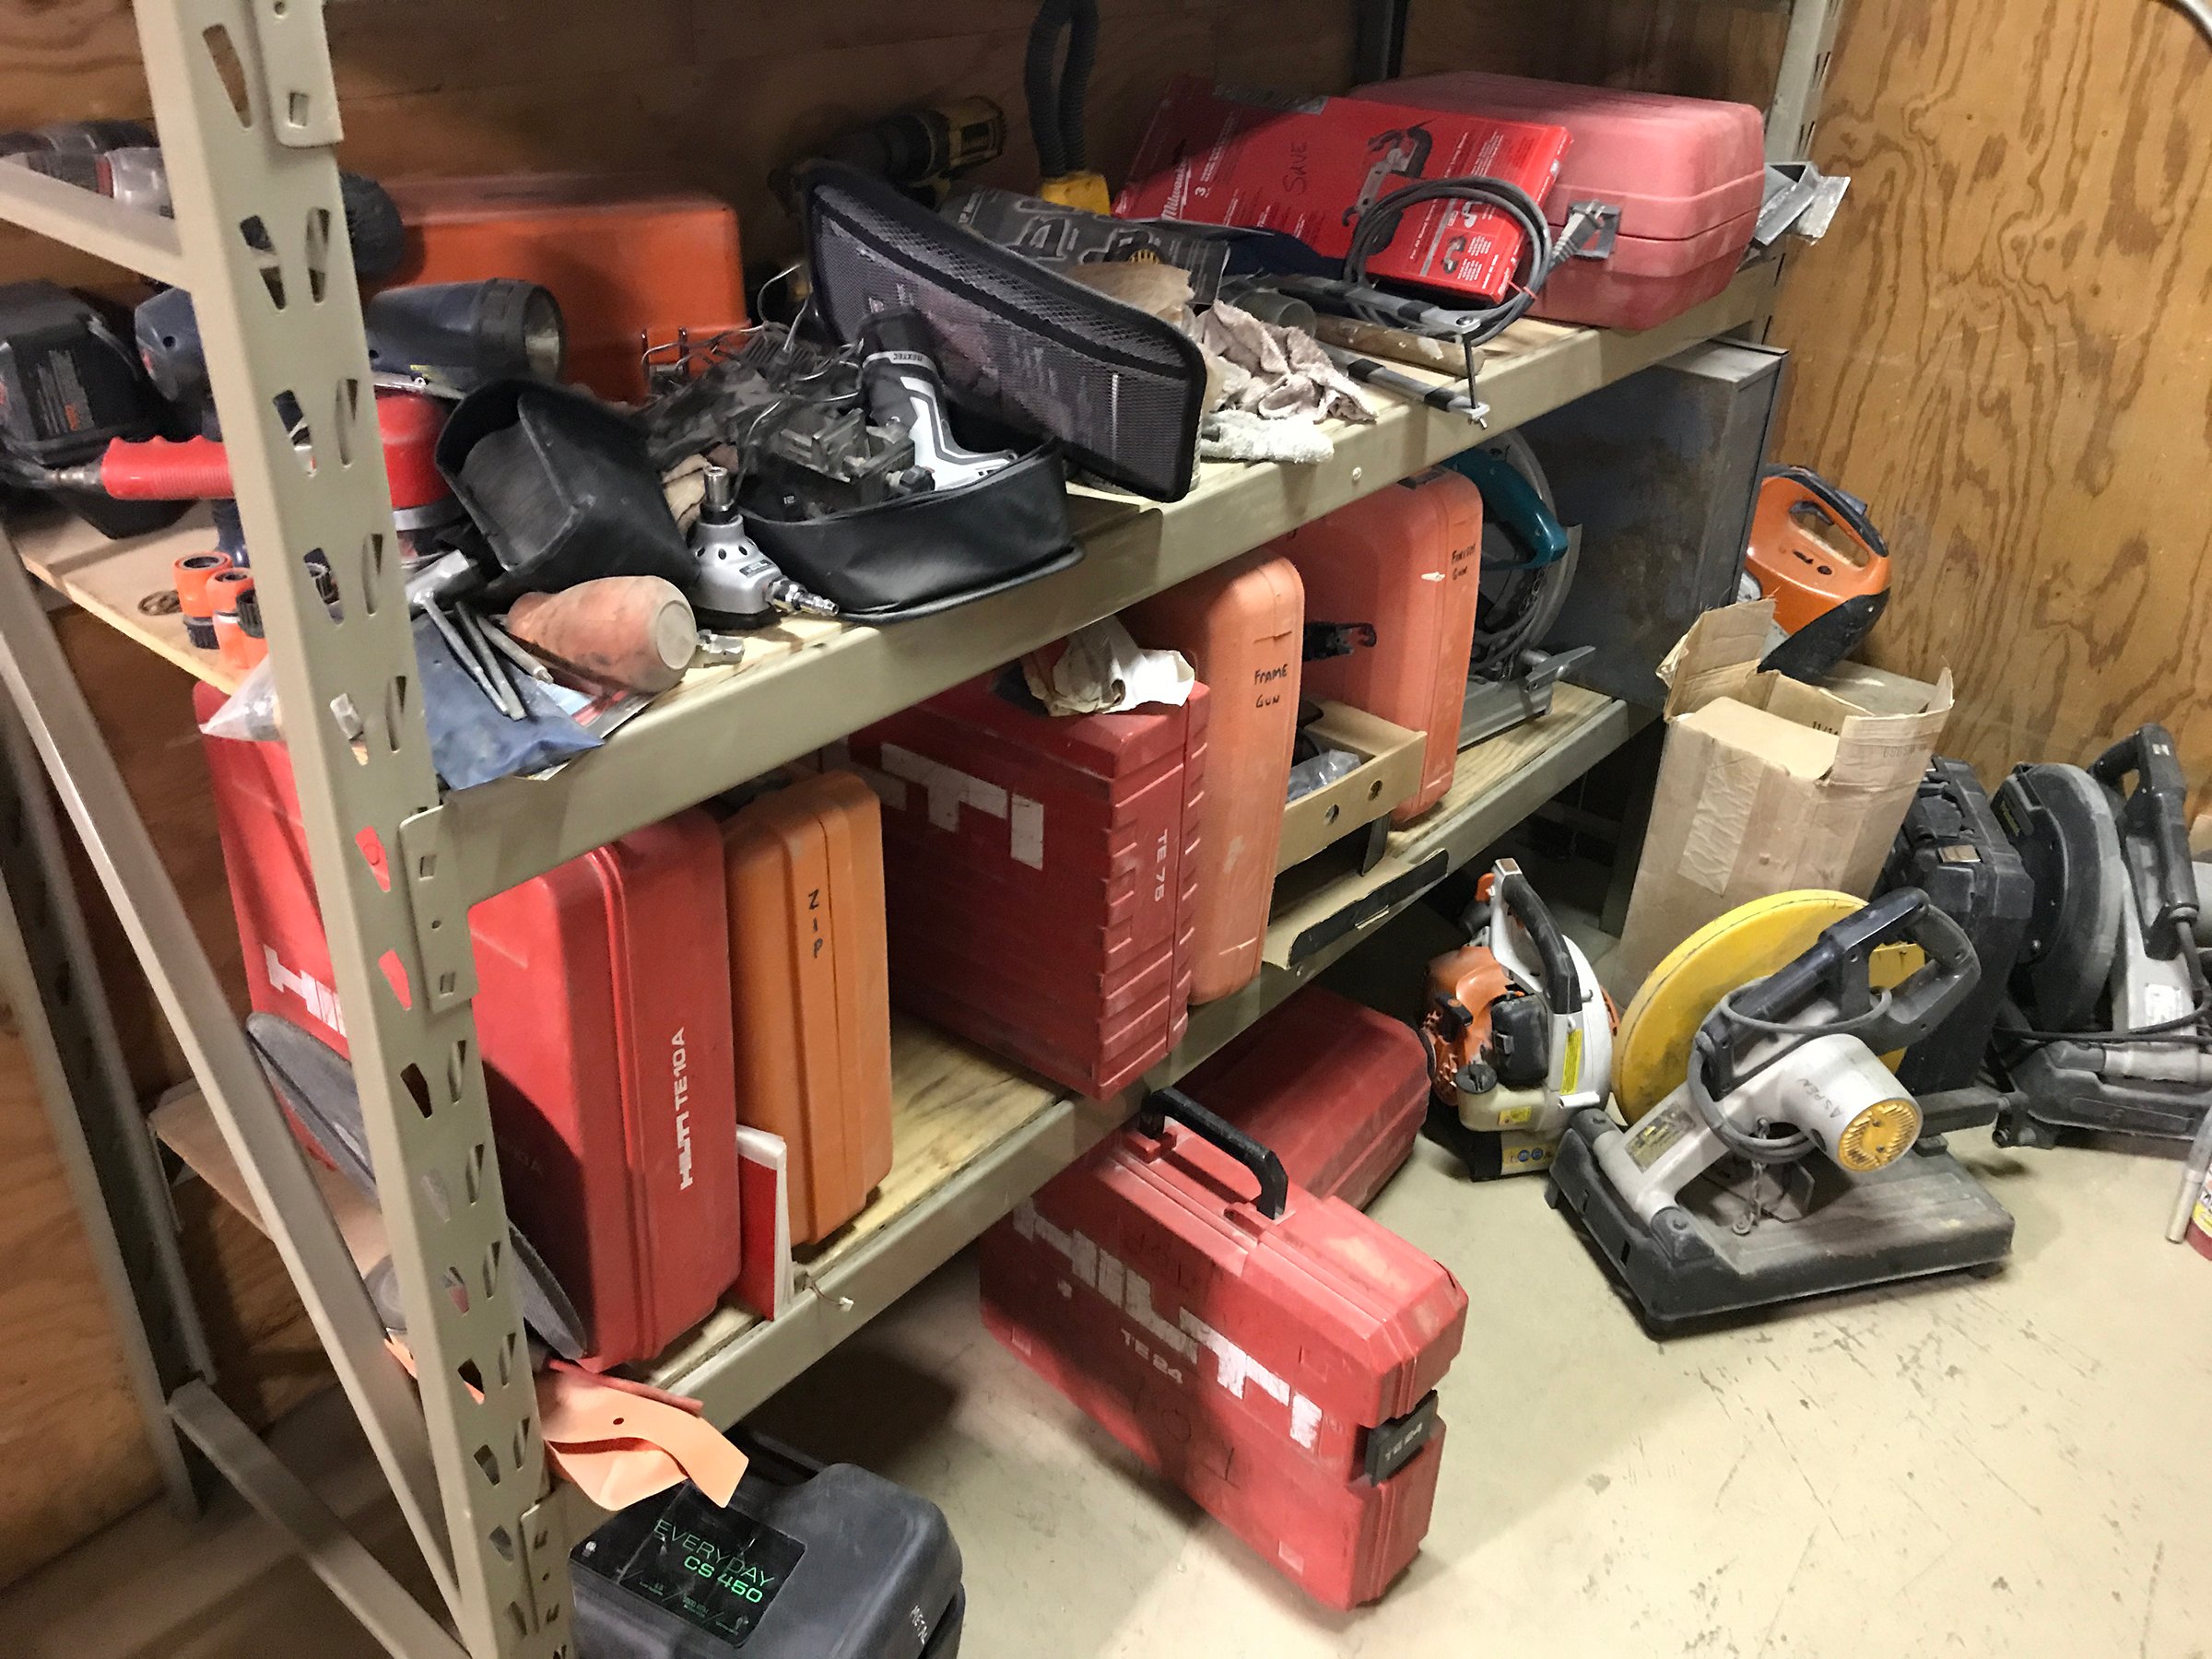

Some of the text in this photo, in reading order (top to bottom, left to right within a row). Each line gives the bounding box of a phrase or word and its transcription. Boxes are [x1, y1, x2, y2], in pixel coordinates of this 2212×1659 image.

[1256, 694, 1280, 708] GUN
[1157, 828, 1168, 864] TE
[808, 888, 823, 959] ZIP
[1795, 1078, 1843, 1118] ASPEN
[677, 1111, 694, 1191] HILTI
[1121, 1327, 1183, 1384] TE 24
[1384, 1422, 1423, 1461] TE 24
[653, 1519, 774, 1587] EVERYDAY
[683, 1555, 763, 1604] CS 450
